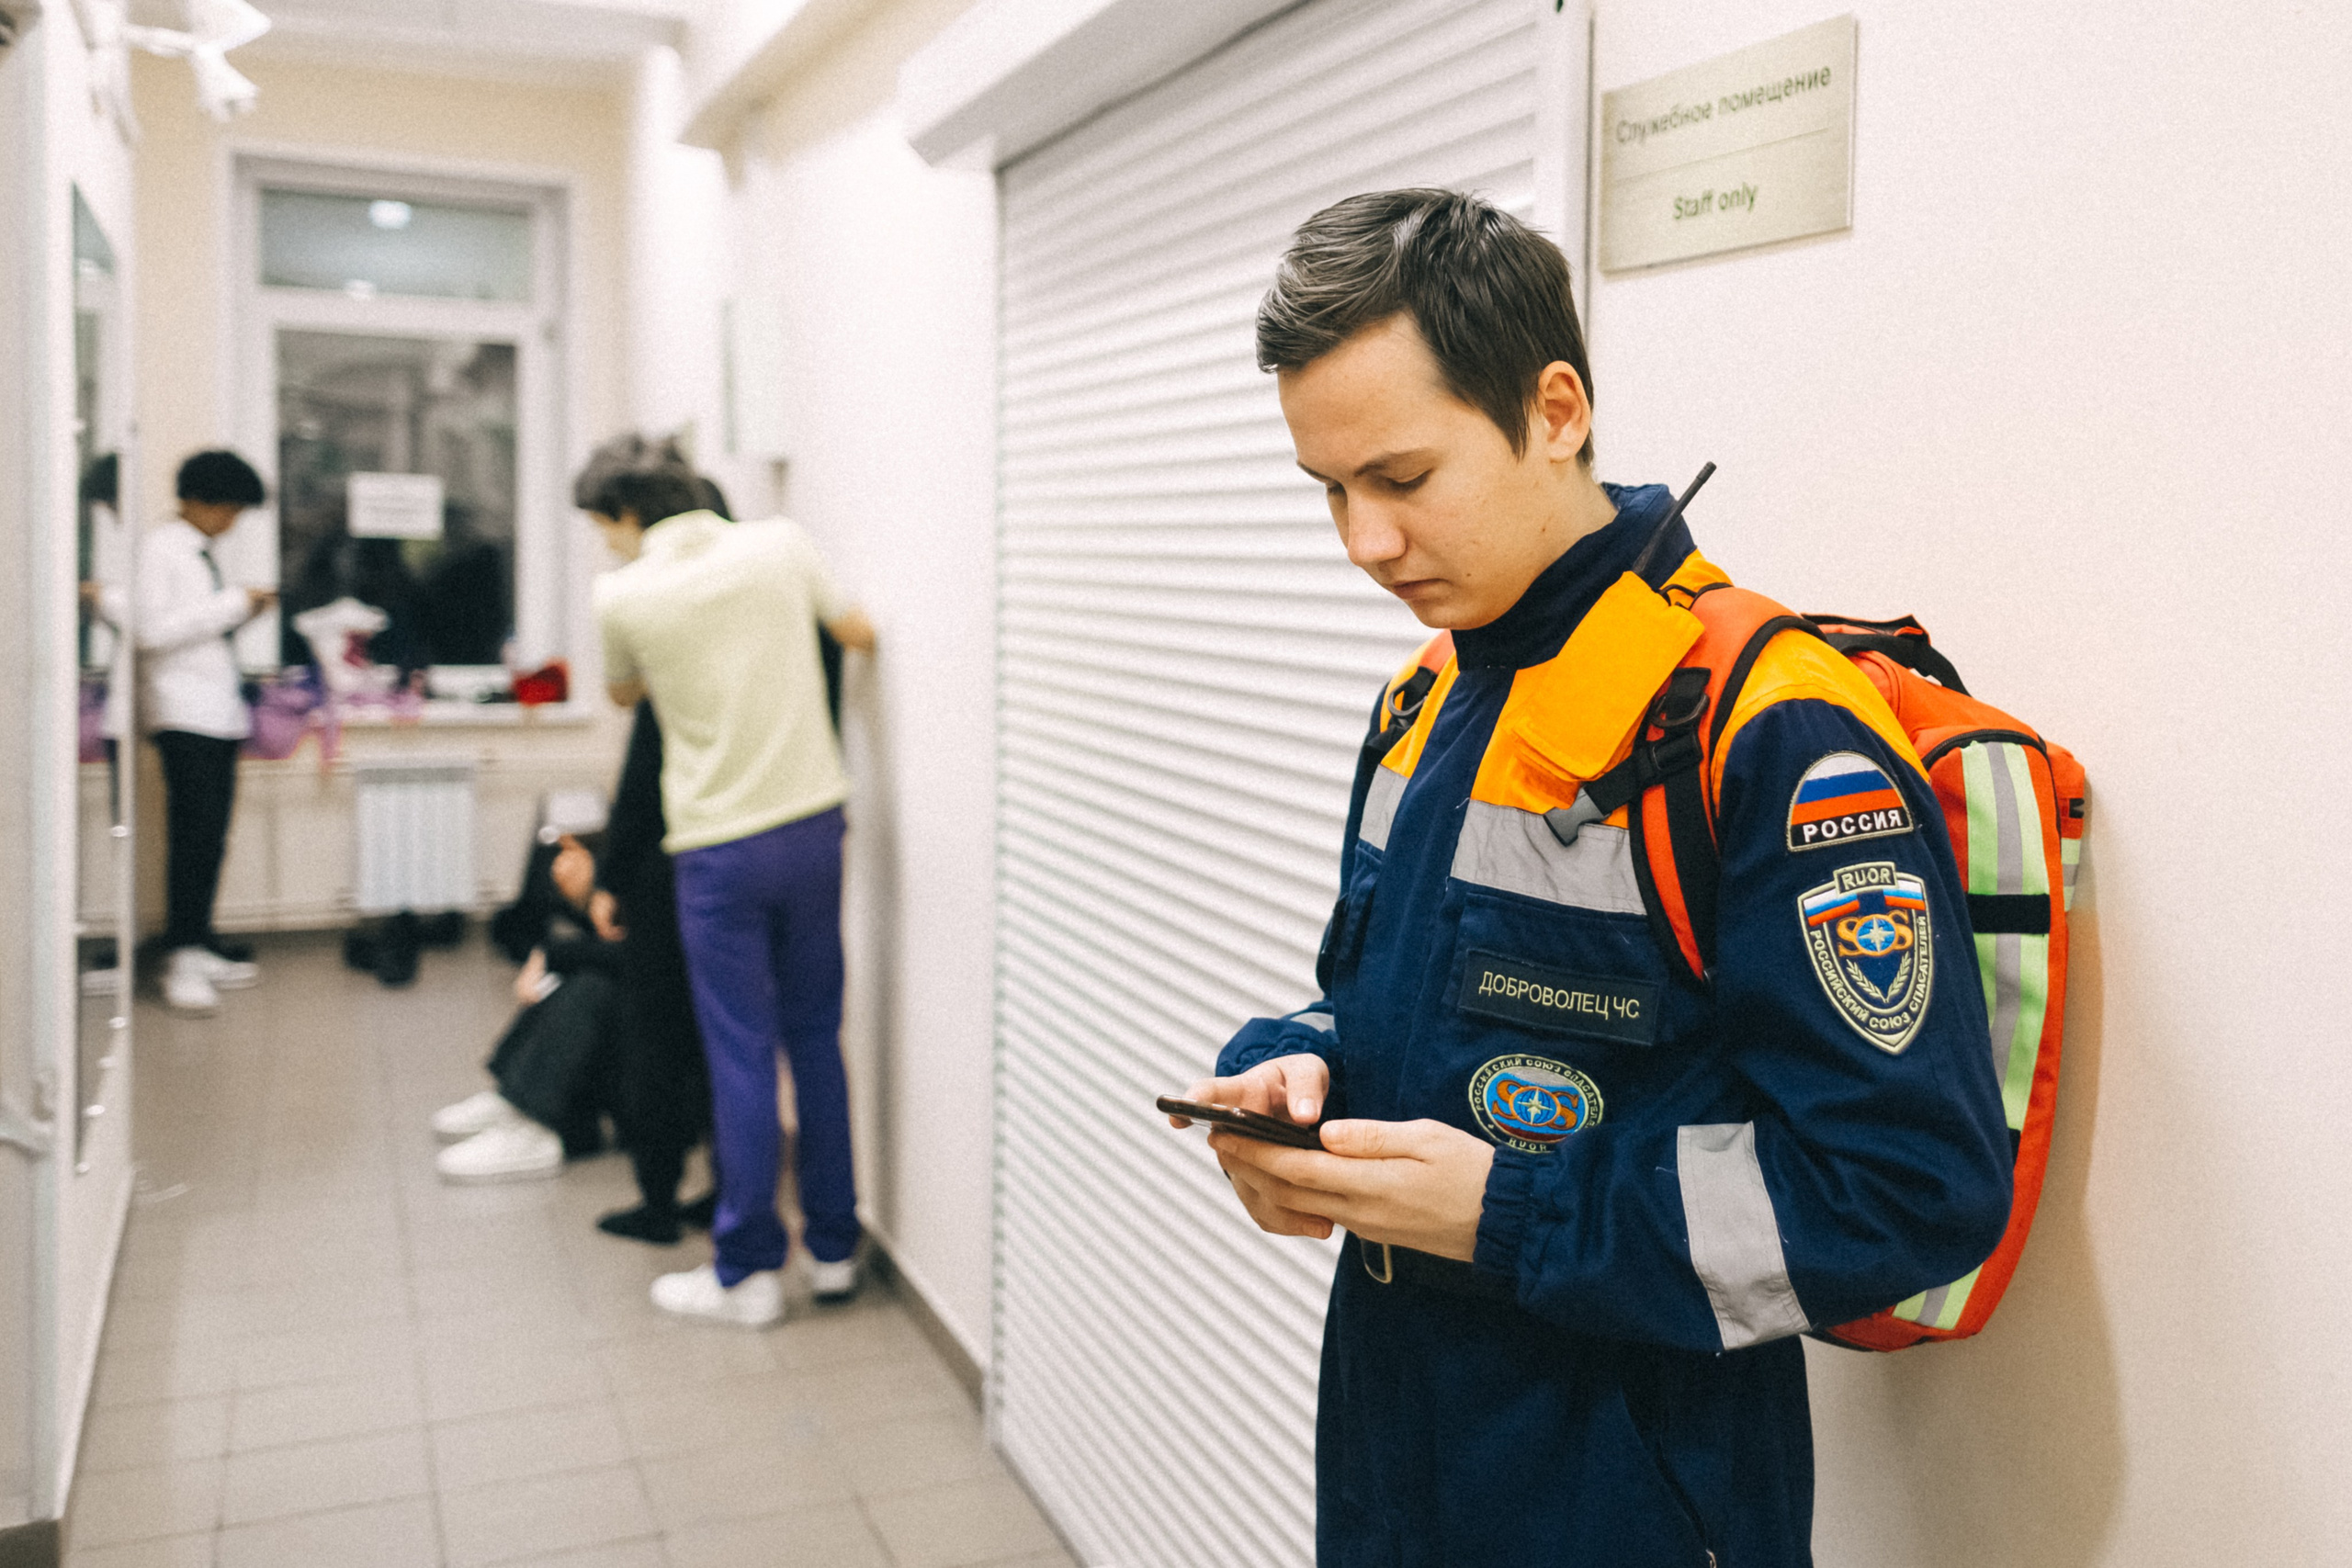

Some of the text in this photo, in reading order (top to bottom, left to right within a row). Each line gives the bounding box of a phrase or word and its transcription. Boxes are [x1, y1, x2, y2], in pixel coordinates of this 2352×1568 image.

[1616, 65, 1831, 145] Служебное помещение
[1674, 182, 1758, 220] Staff only
[1803, 809, 1903, 843] РОССИЯ
[1841, 867, 1892, 891] RUOR
[1478, 971, 1640, 1020] ДОБРОВОЛЕЦ ЧС
[1810, 916, 1928, 1030] РОССИЙСКИЙ СОЮЗ СПАСАТЕЛЕЙ
[1475, 1057, 1599, 1128] РОССИЙСКИЙ СОЮЗ СПАСАТЕЛЕ
